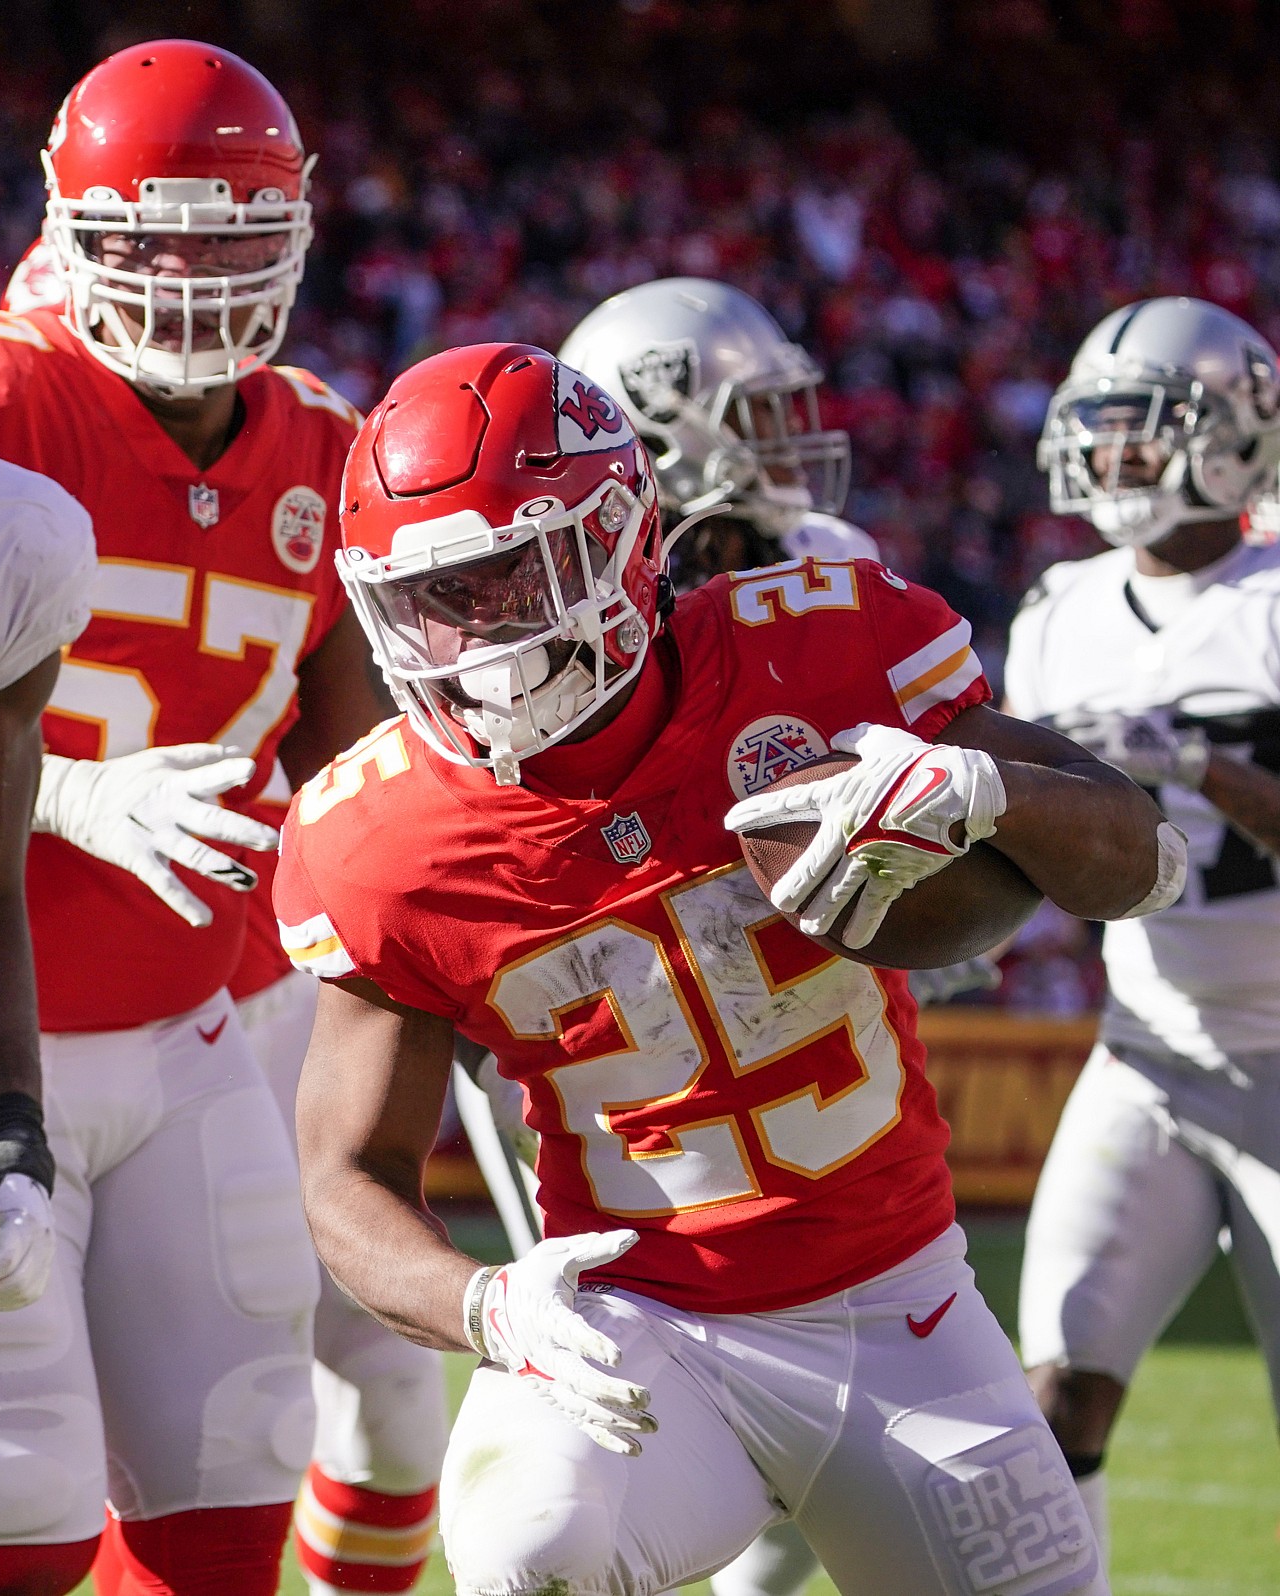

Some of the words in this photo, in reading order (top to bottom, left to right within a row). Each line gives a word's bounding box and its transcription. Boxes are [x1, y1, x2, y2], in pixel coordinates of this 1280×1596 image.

[559, 380, 623, 441] KC
[46, 556, 318, 804] 57
[613, 831, 645, 857] NFL
[489, 858, 907, 1219] 25
[959, 1496, 1089, 1592] 225
